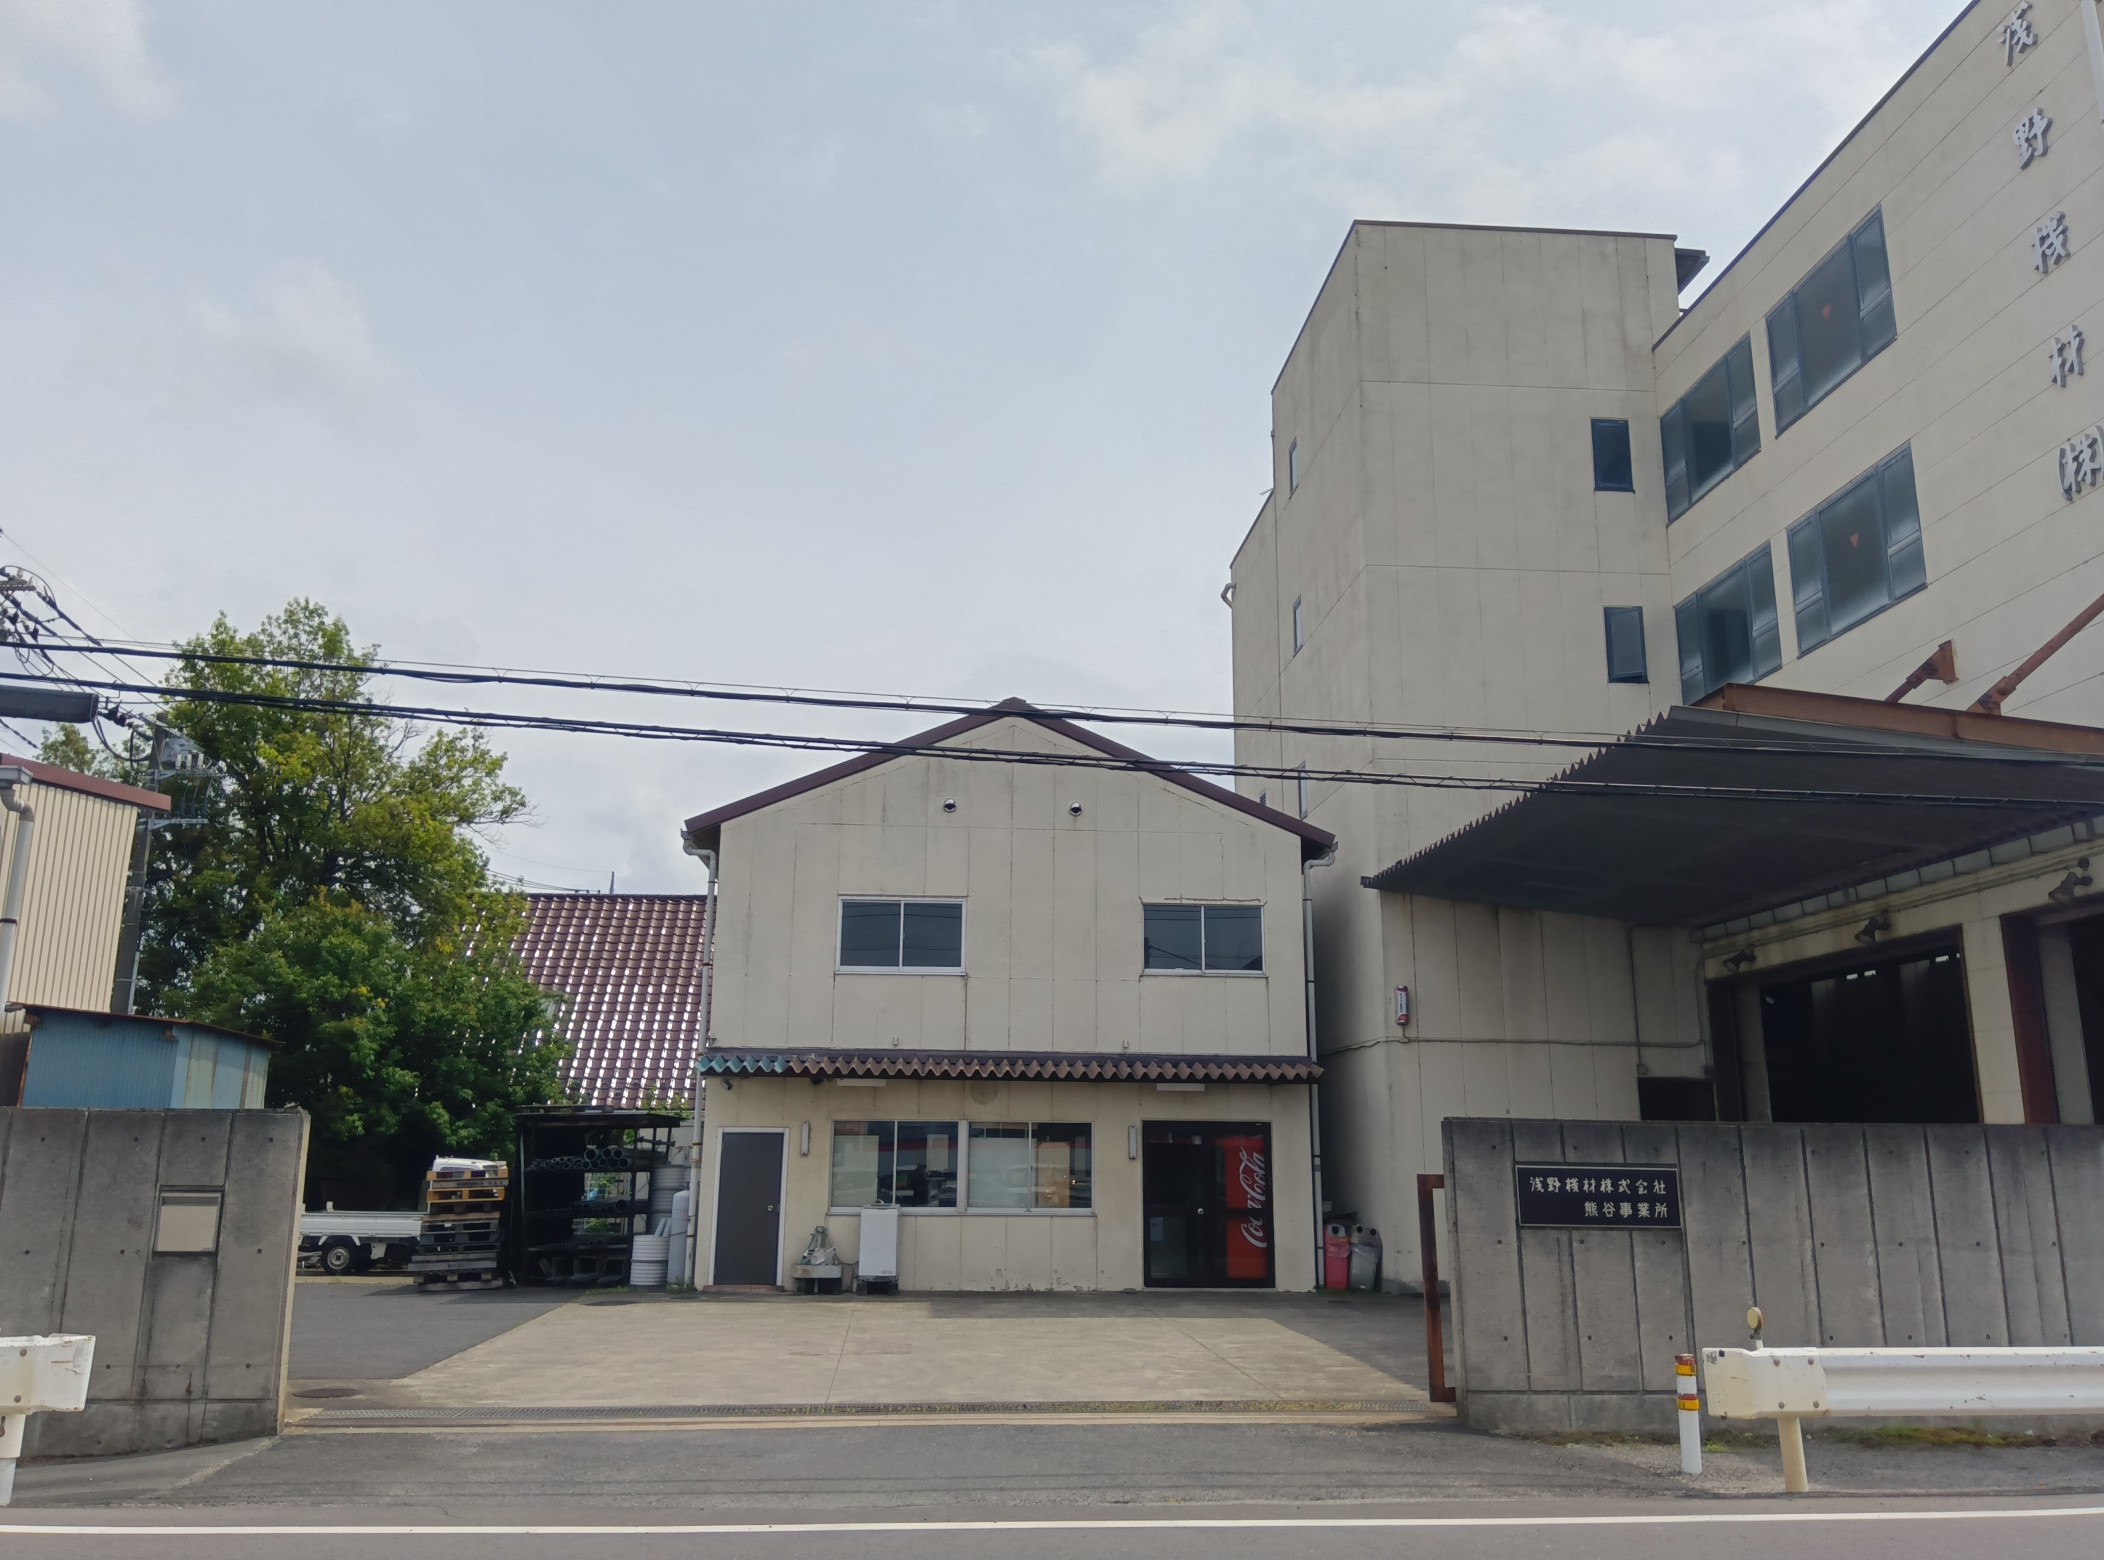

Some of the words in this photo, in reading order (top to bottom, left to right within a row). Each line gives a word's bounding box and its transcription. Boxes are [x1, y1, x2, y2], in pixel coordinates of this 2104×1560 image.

[1529, 1176, 1667, 1195] 浅野機材株式会社
[1584, 1201, 1668, 1218] 熊谷事業所
